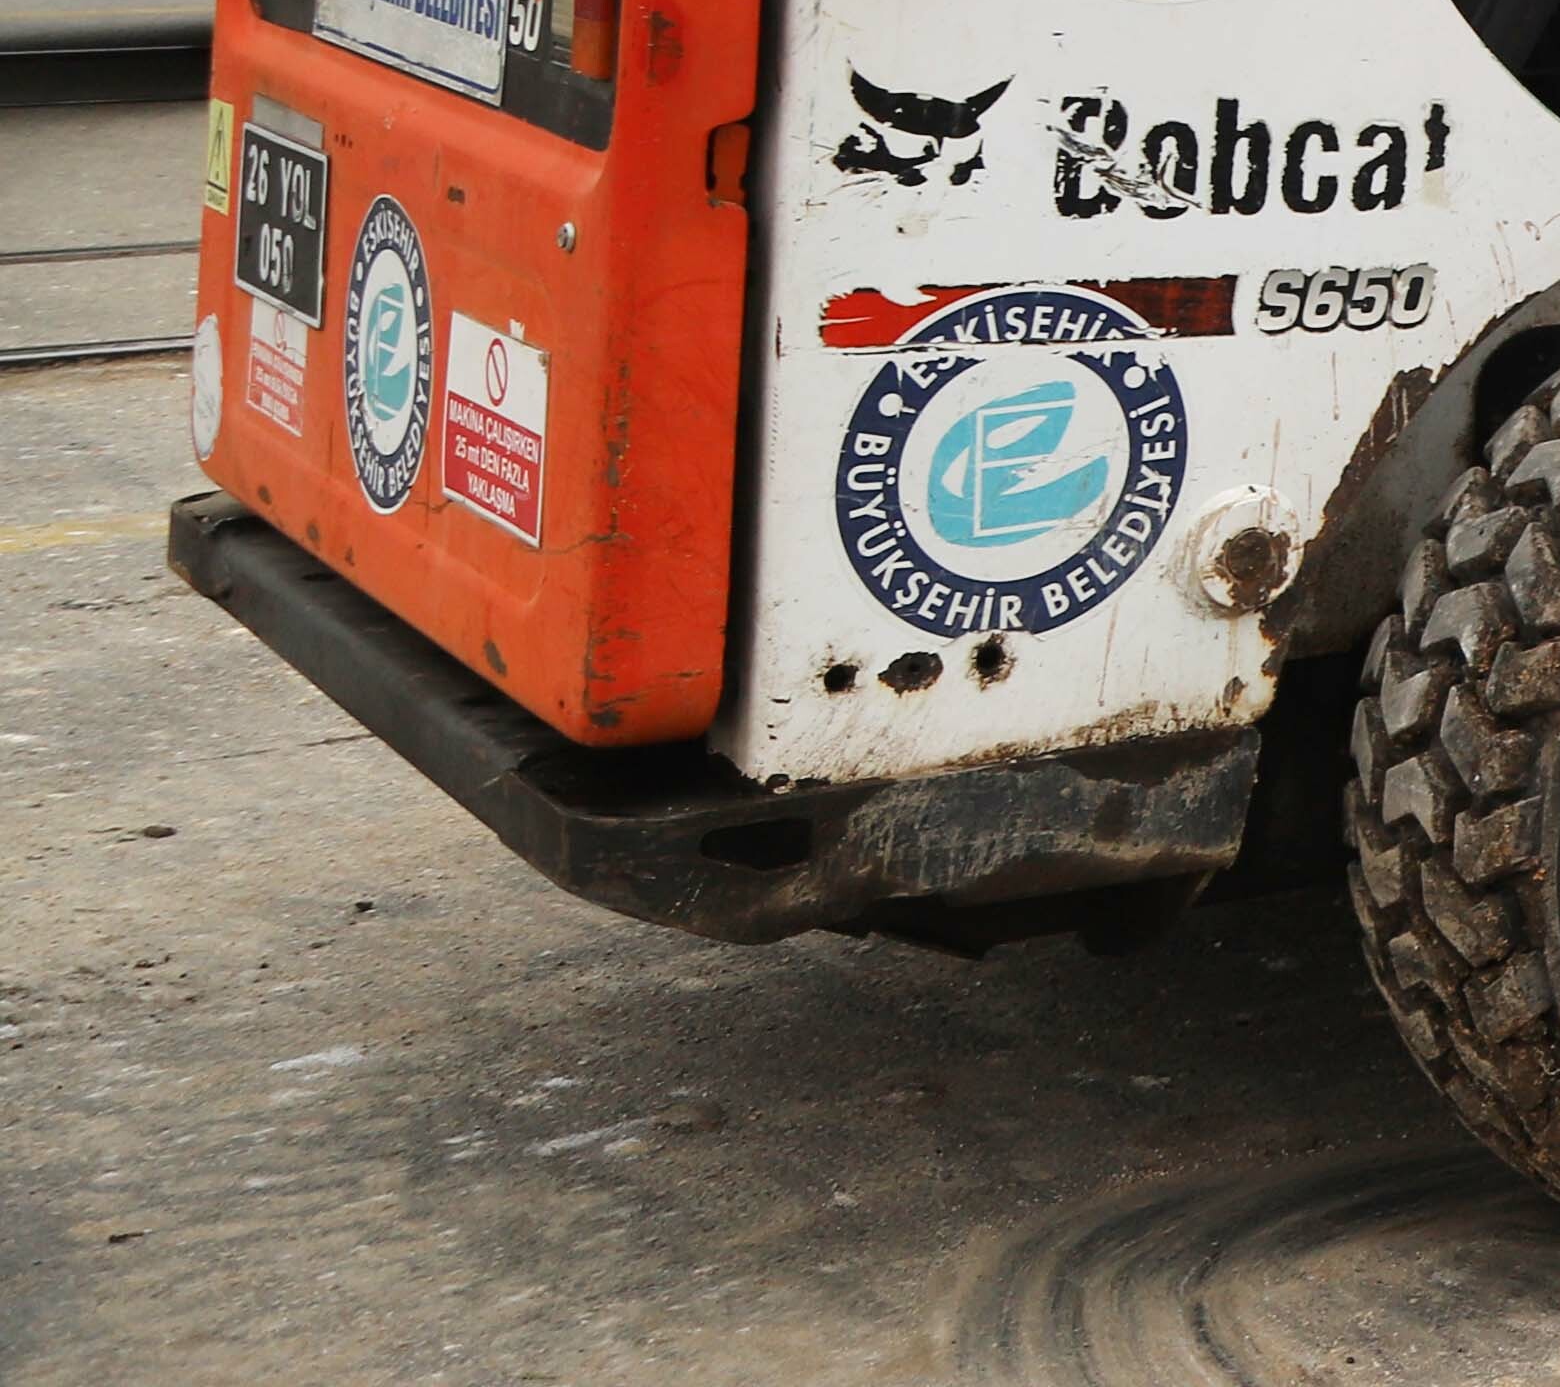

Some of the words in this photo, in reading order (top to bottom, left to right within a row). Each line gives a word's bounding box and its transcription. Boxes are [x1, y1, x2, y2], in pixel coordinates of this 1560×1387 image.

[245, 143, 270, 206] 26
[280, 156, 317, 232] YOL
[1054, 87, 1453, 220] Bobcat
[258, 222, 295, 295] 050
[363, 202, 421, 282] ESKİŞEHİR
[1256, 263, 1437, 337] S650
[387, 320, 431, 498] BELEDİYESİ
[449, 399, 485, 436] MAKİNA
[485, 415, 540, 465] ÇALIŞIRKEN
[454, 434, 468, 459] 25
[467, 446, 480, 467] mt
[479, 447, 501, 477] DEN
[501, 457, 530, 494] FAZLA
[467, 471, 517, 518] YAKLAŞMA
[843, 430, 1024, 631] BÜYÜKŞEHİR
[1040, 397, 1178, 619] BELEDİYESİ
